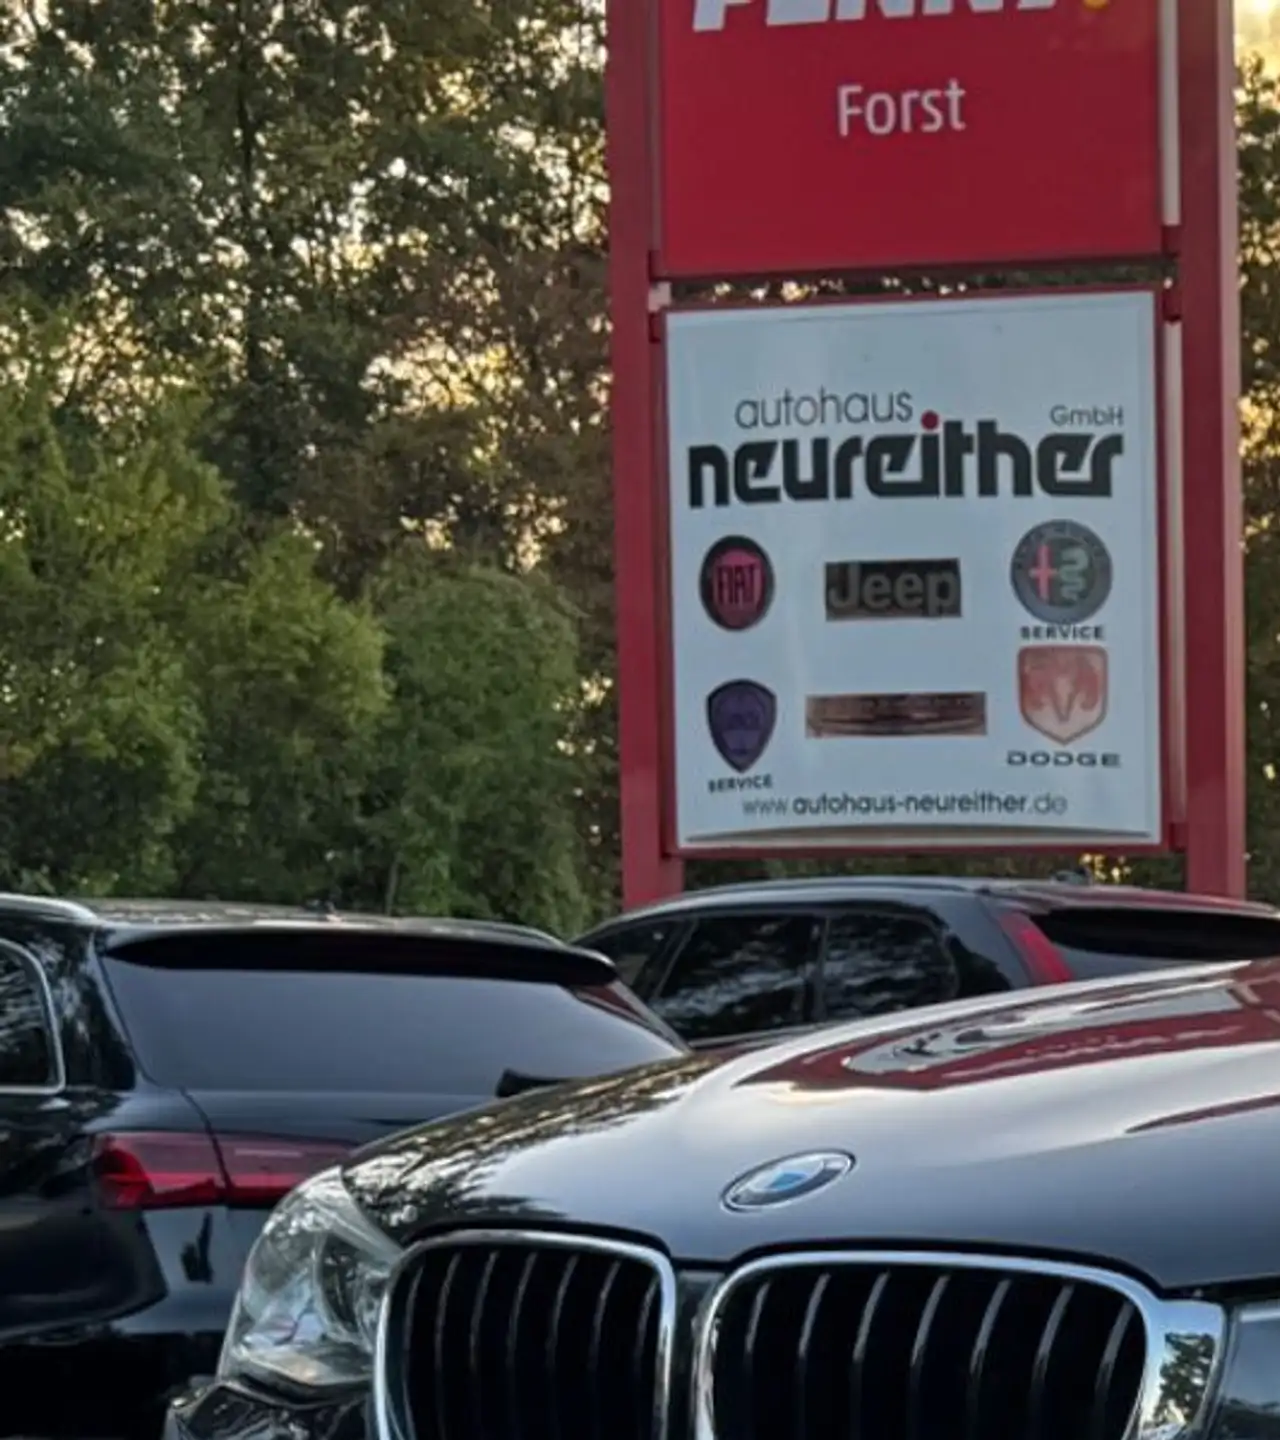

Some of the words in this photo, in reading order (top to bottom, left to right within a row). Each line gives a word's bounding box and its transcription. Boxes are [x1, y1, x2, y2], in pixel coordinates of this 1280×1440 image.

[836, 78, 966, 136] Forst
[735, 386, 914, 430] autohaus
[1049, 405, 1124, 427] GmbH
[688, 411, 1124, 509] neureither
[716, 563, 761, 605] FIAT
[828, 562, 959, 617] Jeep
[1020, 625, 1104, 641] SERVICE
[1006, 750, 1121, 768] DODGE
[707, 774, 773, 793] SERVICE
[742, 790, 1068, 817] www.autohaus-neureither.de
